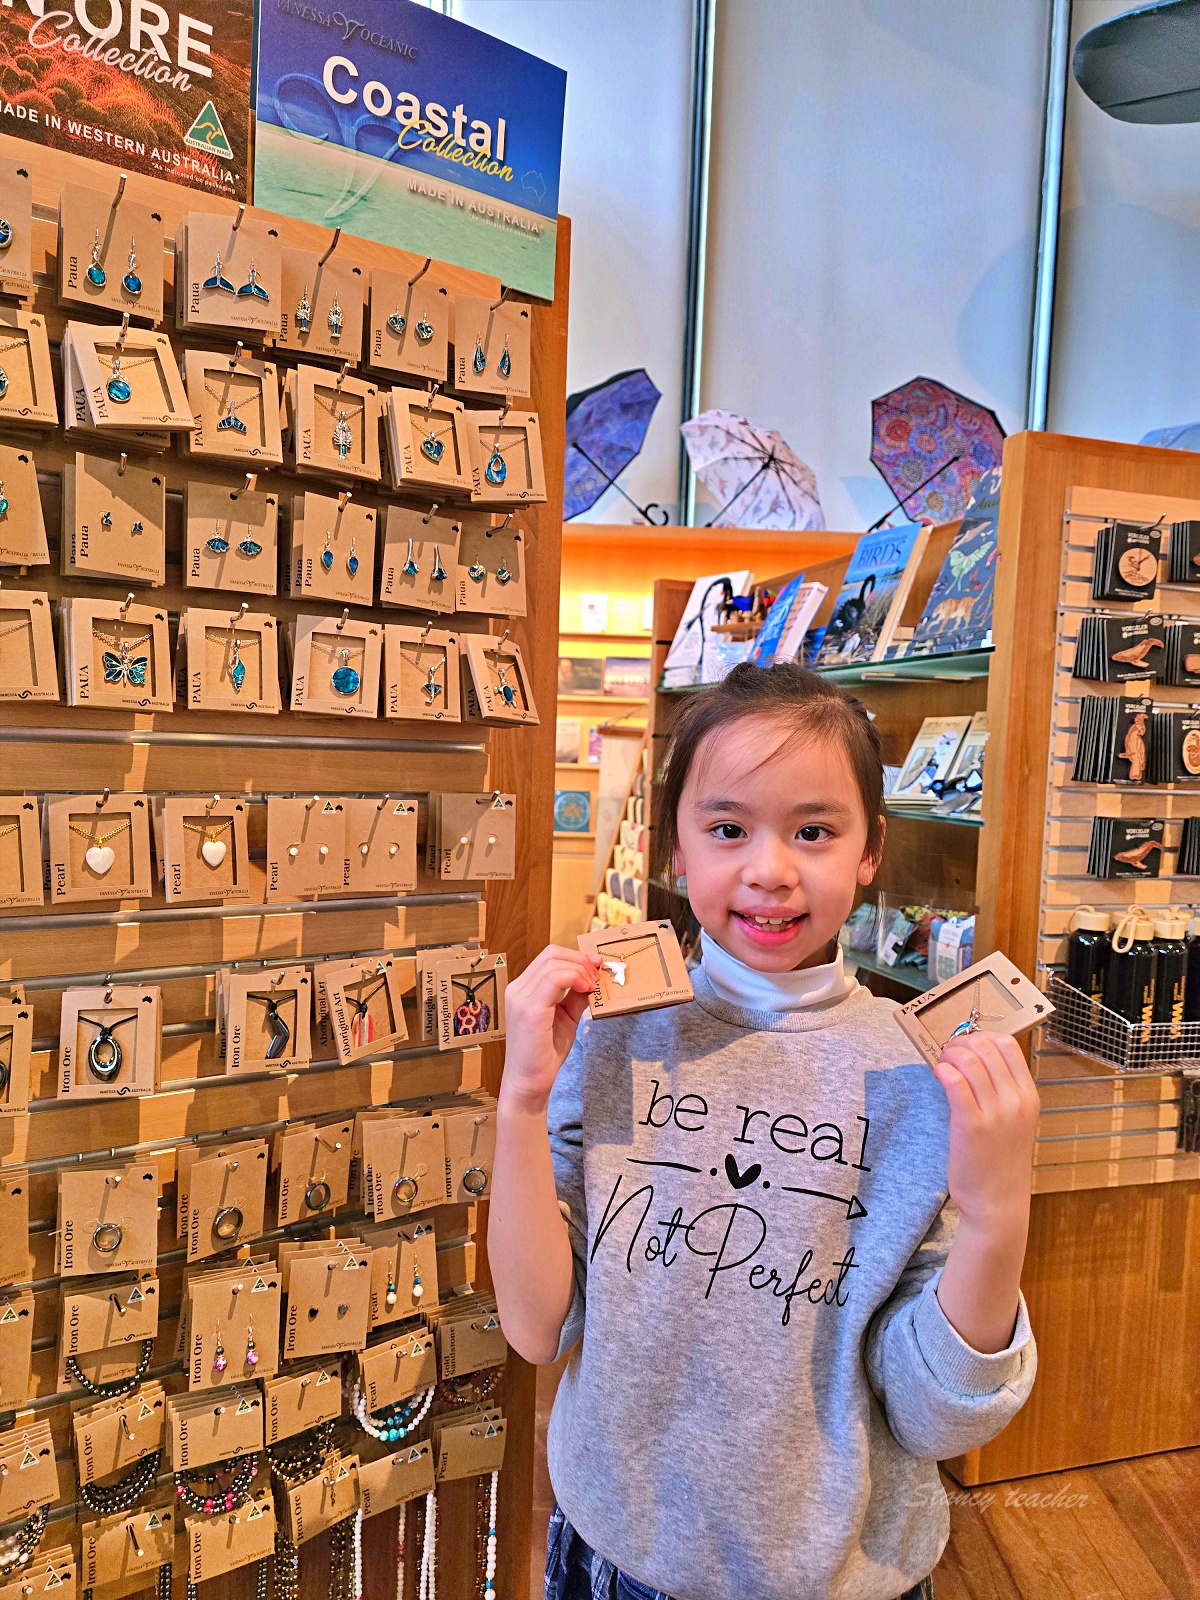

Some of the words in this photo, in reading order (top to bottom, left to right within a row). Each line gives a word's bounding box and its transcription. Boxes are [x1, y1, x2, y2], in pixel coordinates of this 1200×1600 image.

[74, 0, 214, 78] ORE
[277, 0, 331, 27] VANESSA
[360, 28, 418, 59] OCEANIC
[28, 10, 192, 92] Collection
[322, 55, 506, 161] Coastal
[45, 113, 61, 130] IN
[67, 119, 145, 156] WESTERN
[185, 138, 216, 152] AUSTRALIAN
[216, 149, 232, 157] MADE
[397, 119, 514, 182] Collection
[164, 166, 194, 180] indicated
[204, 179, 236, 194] packaging
[407, 179, 446, 201] MADE
[451, 194, 464, 207] IN
[68, 256, 78, 289] Paua
[191, 282, 200, 314] Paua
[280, 313, 288, 343] Paua
[374, 329, 382, 358] Paua
[458, 357, 466, 384] Paua
[77, 388, 86, 423] PAUA
[94, 387, 109, 419] PAUA
[195, 414, 204, 447] PAUA
[303, 428, 312, 460] PAUA
[405, 444, 413, 474] PAUA
[473, 466, 482, 496] PAUA
[80, 524, 89, 558] Paua
[857, 540, 906, 568] BIRDS
[191, 547, 201, 578] Paua
[304, 558, 313, 588] Paua
[385, 566, 395, 595] Paua
[80, 664, 89, 700] PAUA
[192, 671, 201, 704] PAUA
[294, 675, 305, 706] PAUA
[390, 683, 398, 713] PAUA
[487, 685, 495, 713] PAUA
[428, 844, 436, 871] Pearl
[444, 848, 452, 875] Pearl
[56, 862, 66, 896] Pearl
[173, 863, 182, 895] Pearl
[270, 861, 279, 891] Pearl
[425, 971, 433, 986] Art
[438, 979, 448, 994] Art
[333, 992, 342, 1008] Art
[425, 988, 433, 1036] Aboriginal
[901, 992, 937, 1015] PAUA
[319, 998, 329, 1046] Aboriginal
[439, 996, 451, 1044] Aboriginal
[232, 1025, 241, 1043] Ore
[336, 1011, 352, 1057] Aboriginal
[62, 1046, 72, 1065] Ore
[231, 1045, 241, 1068] Iron
[61, 1067, 71, 1093] Iron
[638, 1079, 708, 1132] be
[733, 1105, 871, 1172] real
[351, 1149, 360, 1166] Ore
[281, 1177, 290, 1194] Ore
[180, 1193, 189, 1214] Ore
[281, 1198, 289, 1220] Iron
[376, 1193, 384, 1215] Iron
[64, 1219, 74, 1240] Ore
[179, 1217, 189, 1239] Iron
[190, 1208, 200, 1228] Ore
[64, 1244, 73, 1270] Iron
[189, 1232, 199, 1256] Iron
[590, 1174, 696, 1273] Not
[685, 1203, 860, 1326] Perfect
[69, 1304, 79, 1325] Ore
[287, 1304, 297, 1324] Ore
[69, 1329, 79, 1354] Iron
[193, 1333, 203, 1354] Ore
[287, 1327, 296, 1351] Iron
[192, 1359, 202, 1384] Iron
[270, 1395, 278, 1415] Ore
[369, 1380, 377, 1409] Pearl
[179, 1419, 188, 1439] Ore
[270, 1418, 278, 1442] Iron
[83, 1433, 92, 1454] Ore
[179, 1442, 188, 1467] Iron
[84, 1459, 94, 1482] Iron
[439, 1451, 449, 1479] Pearl
[294, 1495, 302, 1514] Ore
[363, 1488, 371, 1515] Pearl
[193, 1531, 201, 1551] Ore
[296, 1518, 304, 1542] Iron
[87, 1536, 97, 1557] Ore
[87, 1560, 96, 1586] Iron
[193, 1555, 202, 1581] Iron
